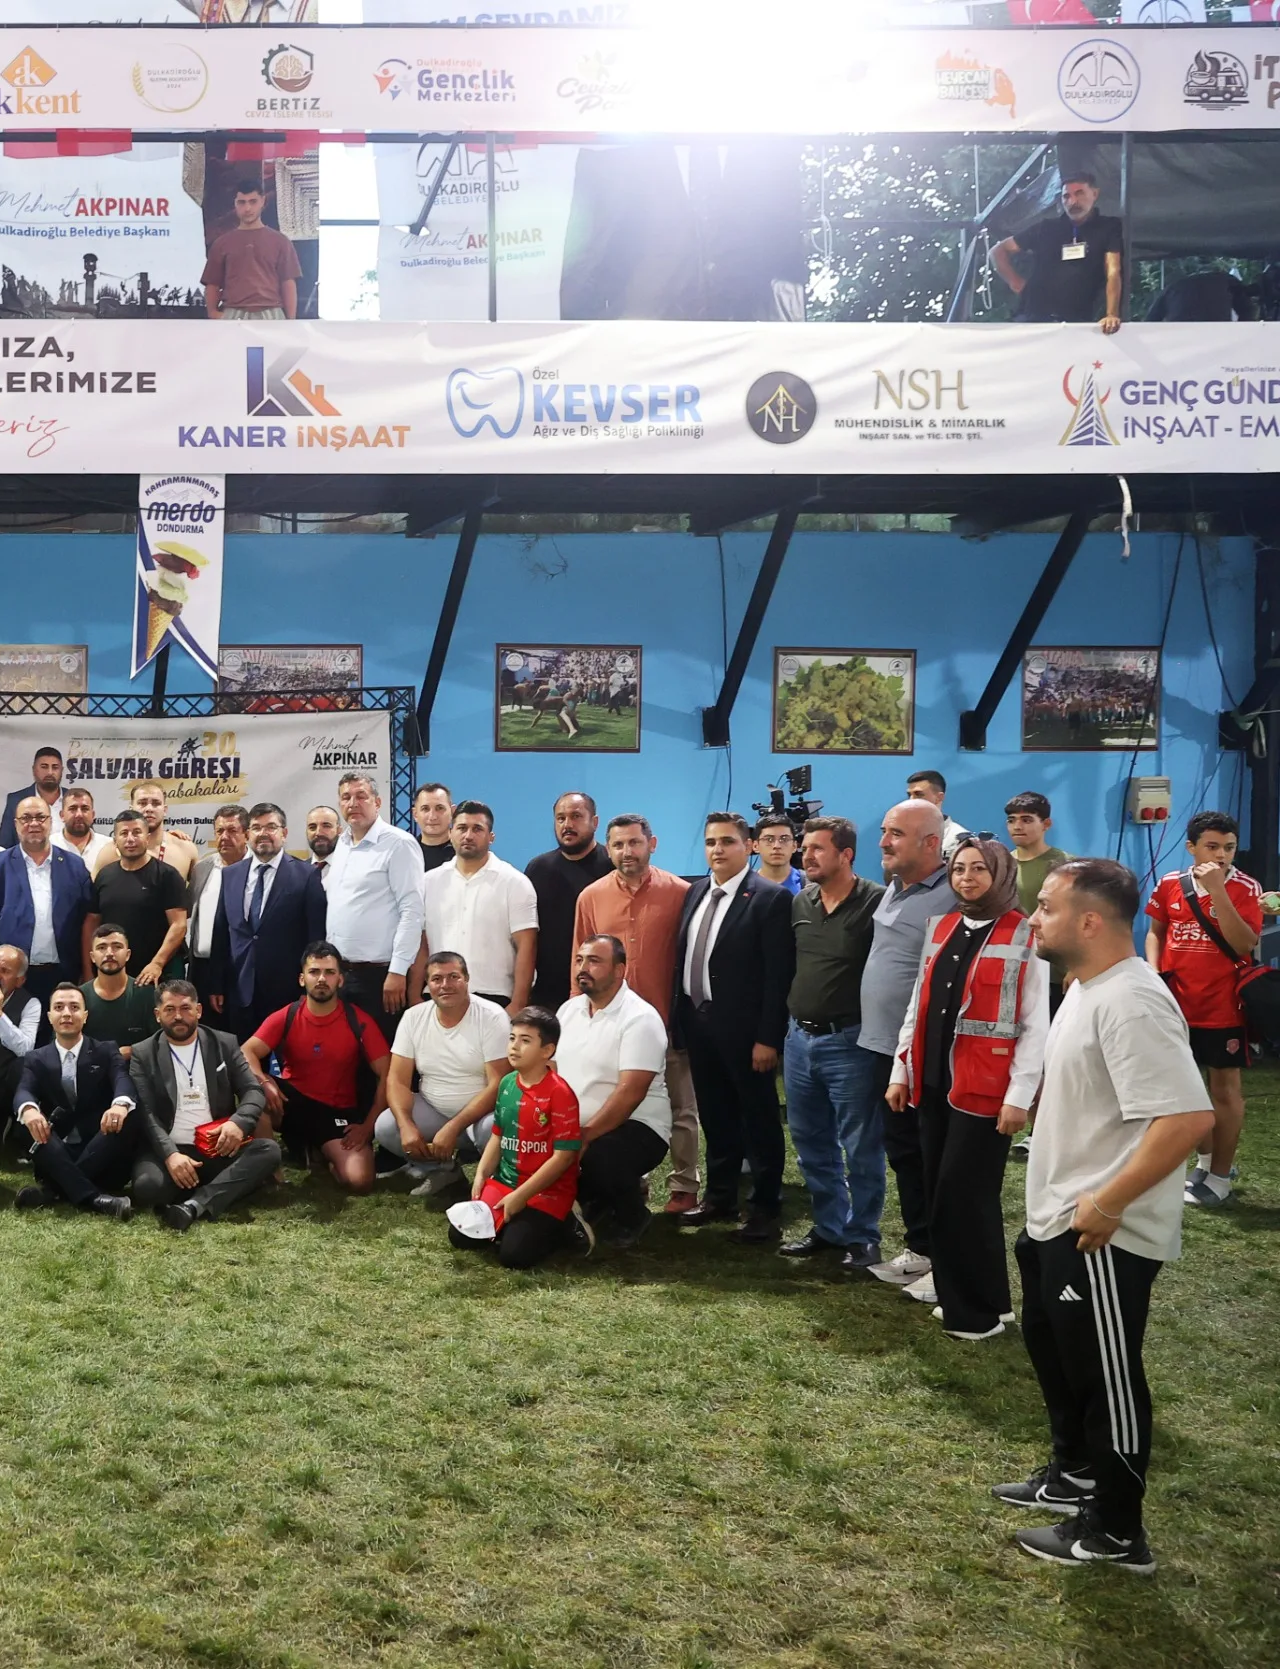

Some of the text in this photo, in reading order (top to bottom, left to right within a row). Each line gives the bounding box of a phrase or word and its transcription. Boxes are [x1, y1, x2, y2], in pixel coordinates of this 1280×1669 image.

[417, 67, 516, 91] Gençlik
[417, 88, 517, 102] Merkezleri
[1064, 88, 1133, 99] DULKADİROĞLU
[256, 97, 321, 111] BERTİZ
[74, 198, 170, 217] AKPINAR
[69, 226, 121, 239] Belediye
[123, 225, 171, 239] Başkanı
[532, 366, 560, 380] Özel
[872, 368, 970, 411] NSH
[1120, 379, 1200, 410] GENÇ
[533, 384, 703, 423] KEVSER
[834, 417, 1006, 428] MÜHENDİSLİK & MİMARLIK
[1123, 414, 1220, 446] İNŞAAT
[178, 424, 411, 452] KANER İNŞAAT
[533, 425, 704, 439] Ağız ve Diş Sağlığı Polikliniği
[145, 475, 220, 499] KAHRAMANMARAŞ
[147, 500, 216, 523] merdo
[156, 523, 204, 534] DONDURMA
[312, 751, 378, 766] AKPINAR
[65, 757, 153, 784] ŞALVAR
[521, 1140, 548, 1153] SPOR
